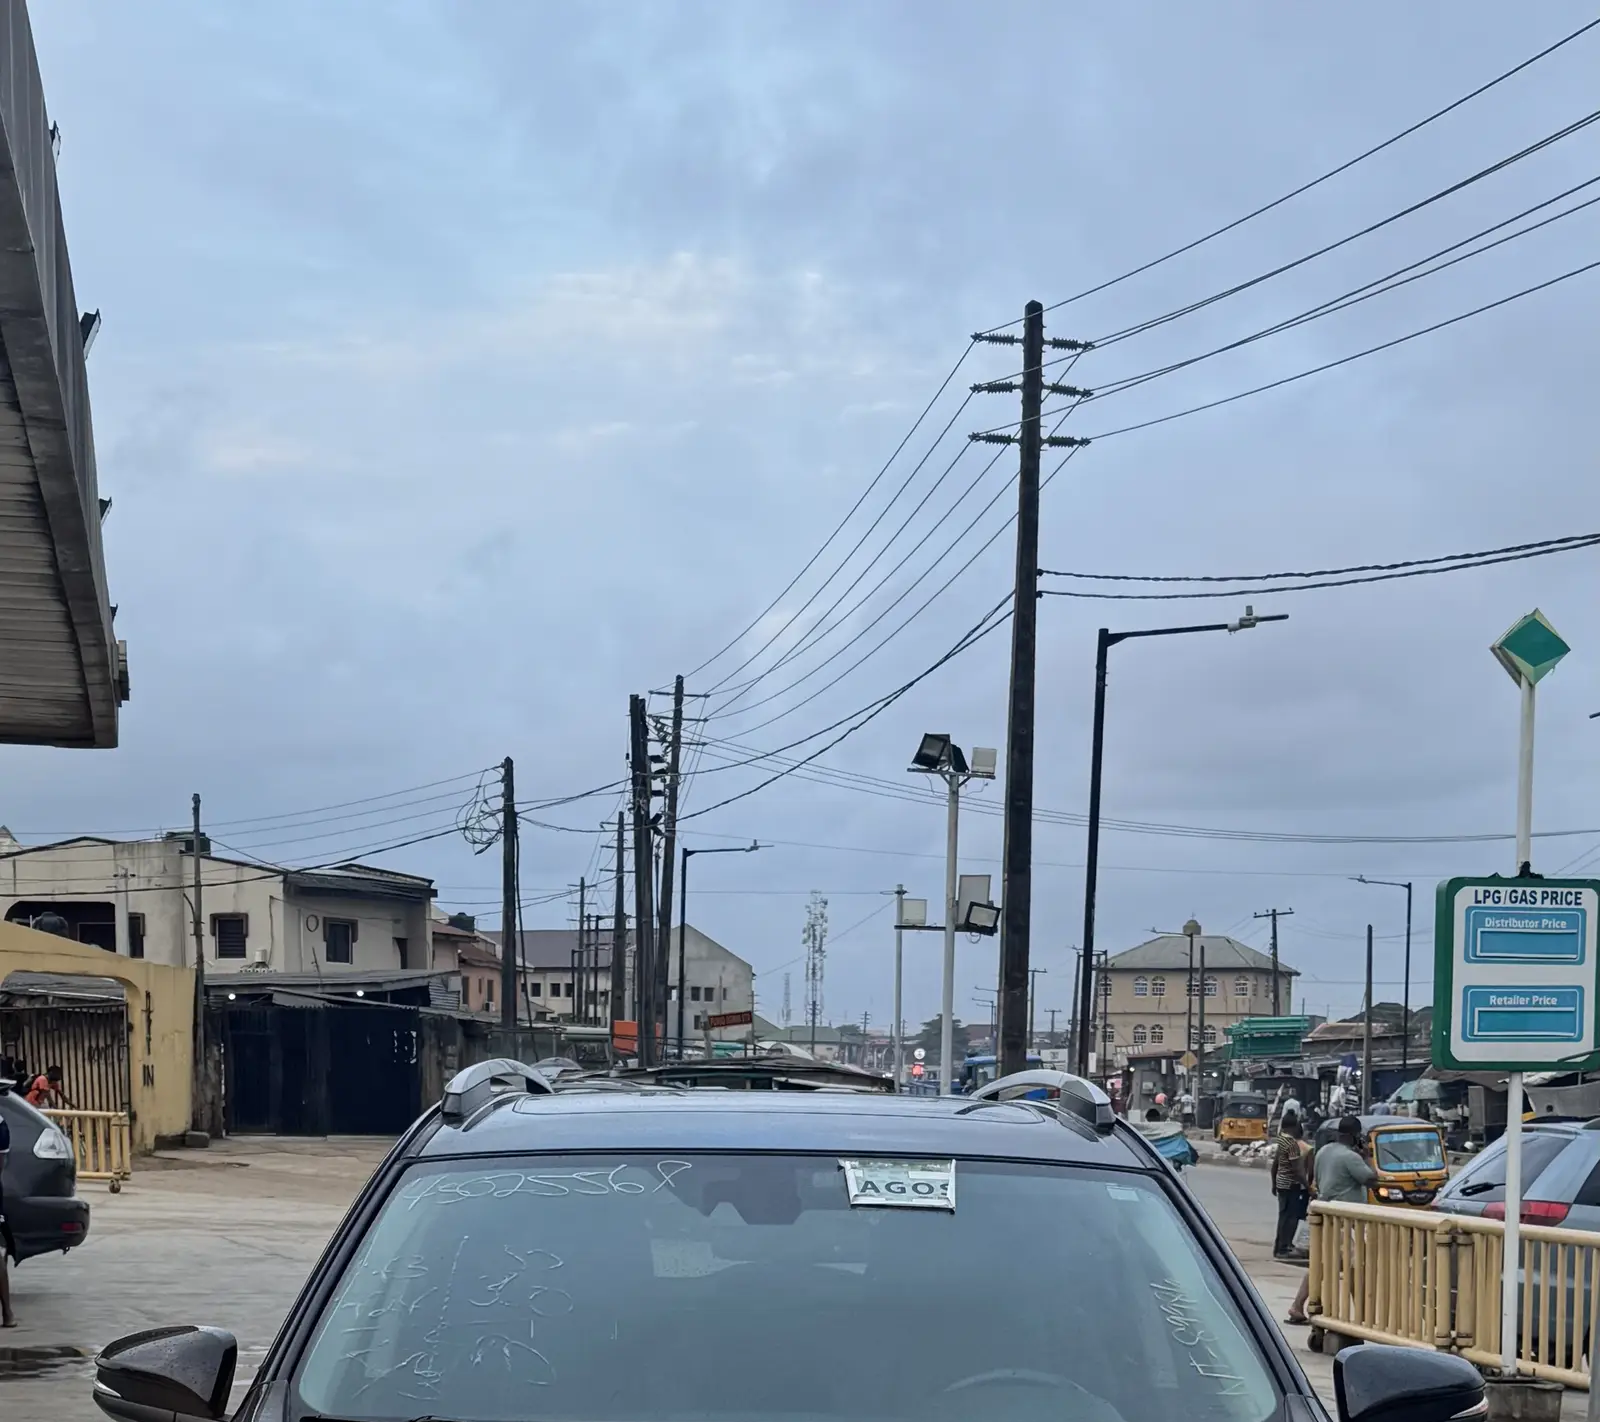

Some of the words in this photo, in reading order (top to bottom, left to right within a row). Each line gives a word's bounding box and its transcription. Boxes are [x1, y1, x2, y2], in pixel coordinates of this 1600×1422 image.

[1541, 891, 1582, 905] PRICE
[1485, 917, 1539, 928] Distributor
[1542, 919, 1567, 929] Price
[1489, 995, 1530, 1005] Retailer
[1532, 995, 1558, 1005] Price
